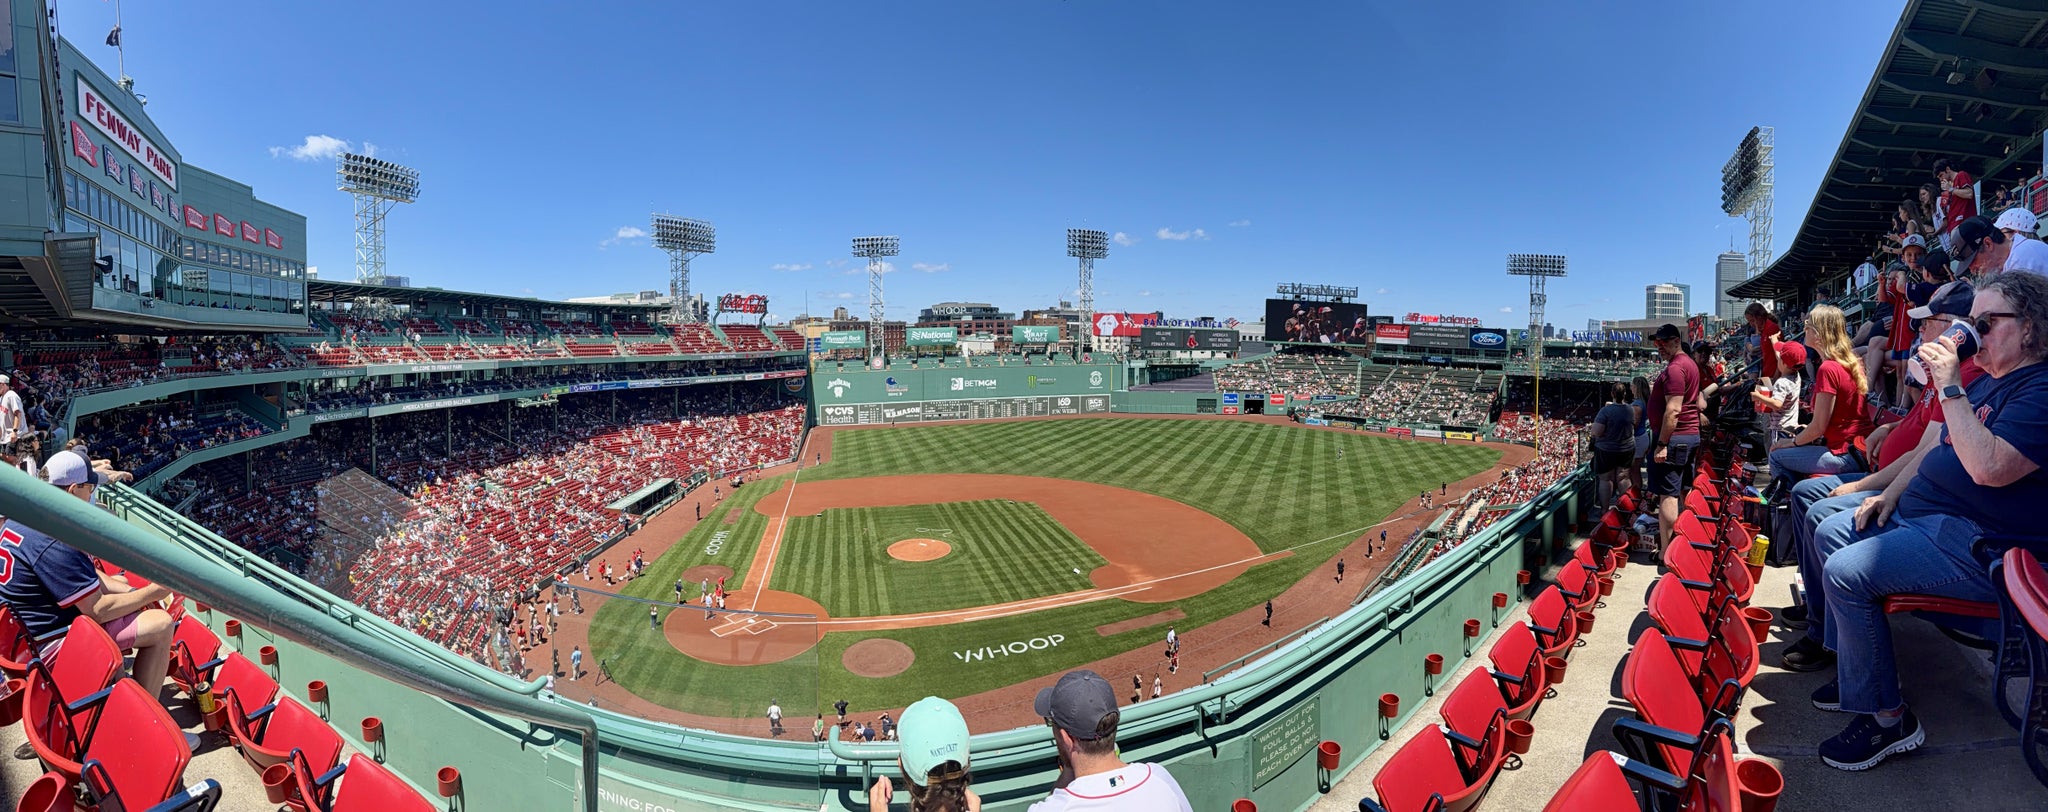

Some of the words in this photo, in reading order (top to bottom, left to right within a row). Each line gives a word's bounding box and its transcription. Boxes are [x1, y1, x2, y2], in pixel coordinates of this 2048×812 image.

[85, 91, 141, 154] FENWAY
[146, 145, 173, 182] PARK
[1292, 282, 1358, 298] MassMutual
[932, 306, 967, 315] WHOOP
[1143, 318, 1169, 327] BANK
[1171, 320, 1183, 328] OF
[1184, 320, 1223, 328] AMERICA
[1439, 314, 1478, 324] balance
[825, 336, 848, 344] Plymouth
[920, 331, 953, 339] National
[1478, 333, 1498, 343] Ford
[1571, 330, 1605, 343] SAMUEL
[1607, 330, 1643, 344] ADAMS
[786, 377, 804, 386] Gulf
[964, 379, 997, 387] BETMGM
[834, 406, 853, 415] CVS
[826, 414, 853, 424] Health
[704, 530, 731, 556] WHOOP
[953, 634, 1065, 663] WHOOP
[1259, 723, 1284, 743] WATCH
[1285, 712, 1300, 727] OUT
[1301, 702, 1316, 717] FOR
[1263, 738, 1284, 753] FOUL
[1284, 720, 1306, 738] BALLS
[1260, 742, 1288, 766] PLEASE
[1290, 734, 1301, 746] DO
[1302, 723, 1315, 737] NOT
[1256, 759, 1283, 780] REACH
[1283, 744, 1303, 761] OVER
[1304, 733, 1318, 745] RAIL
